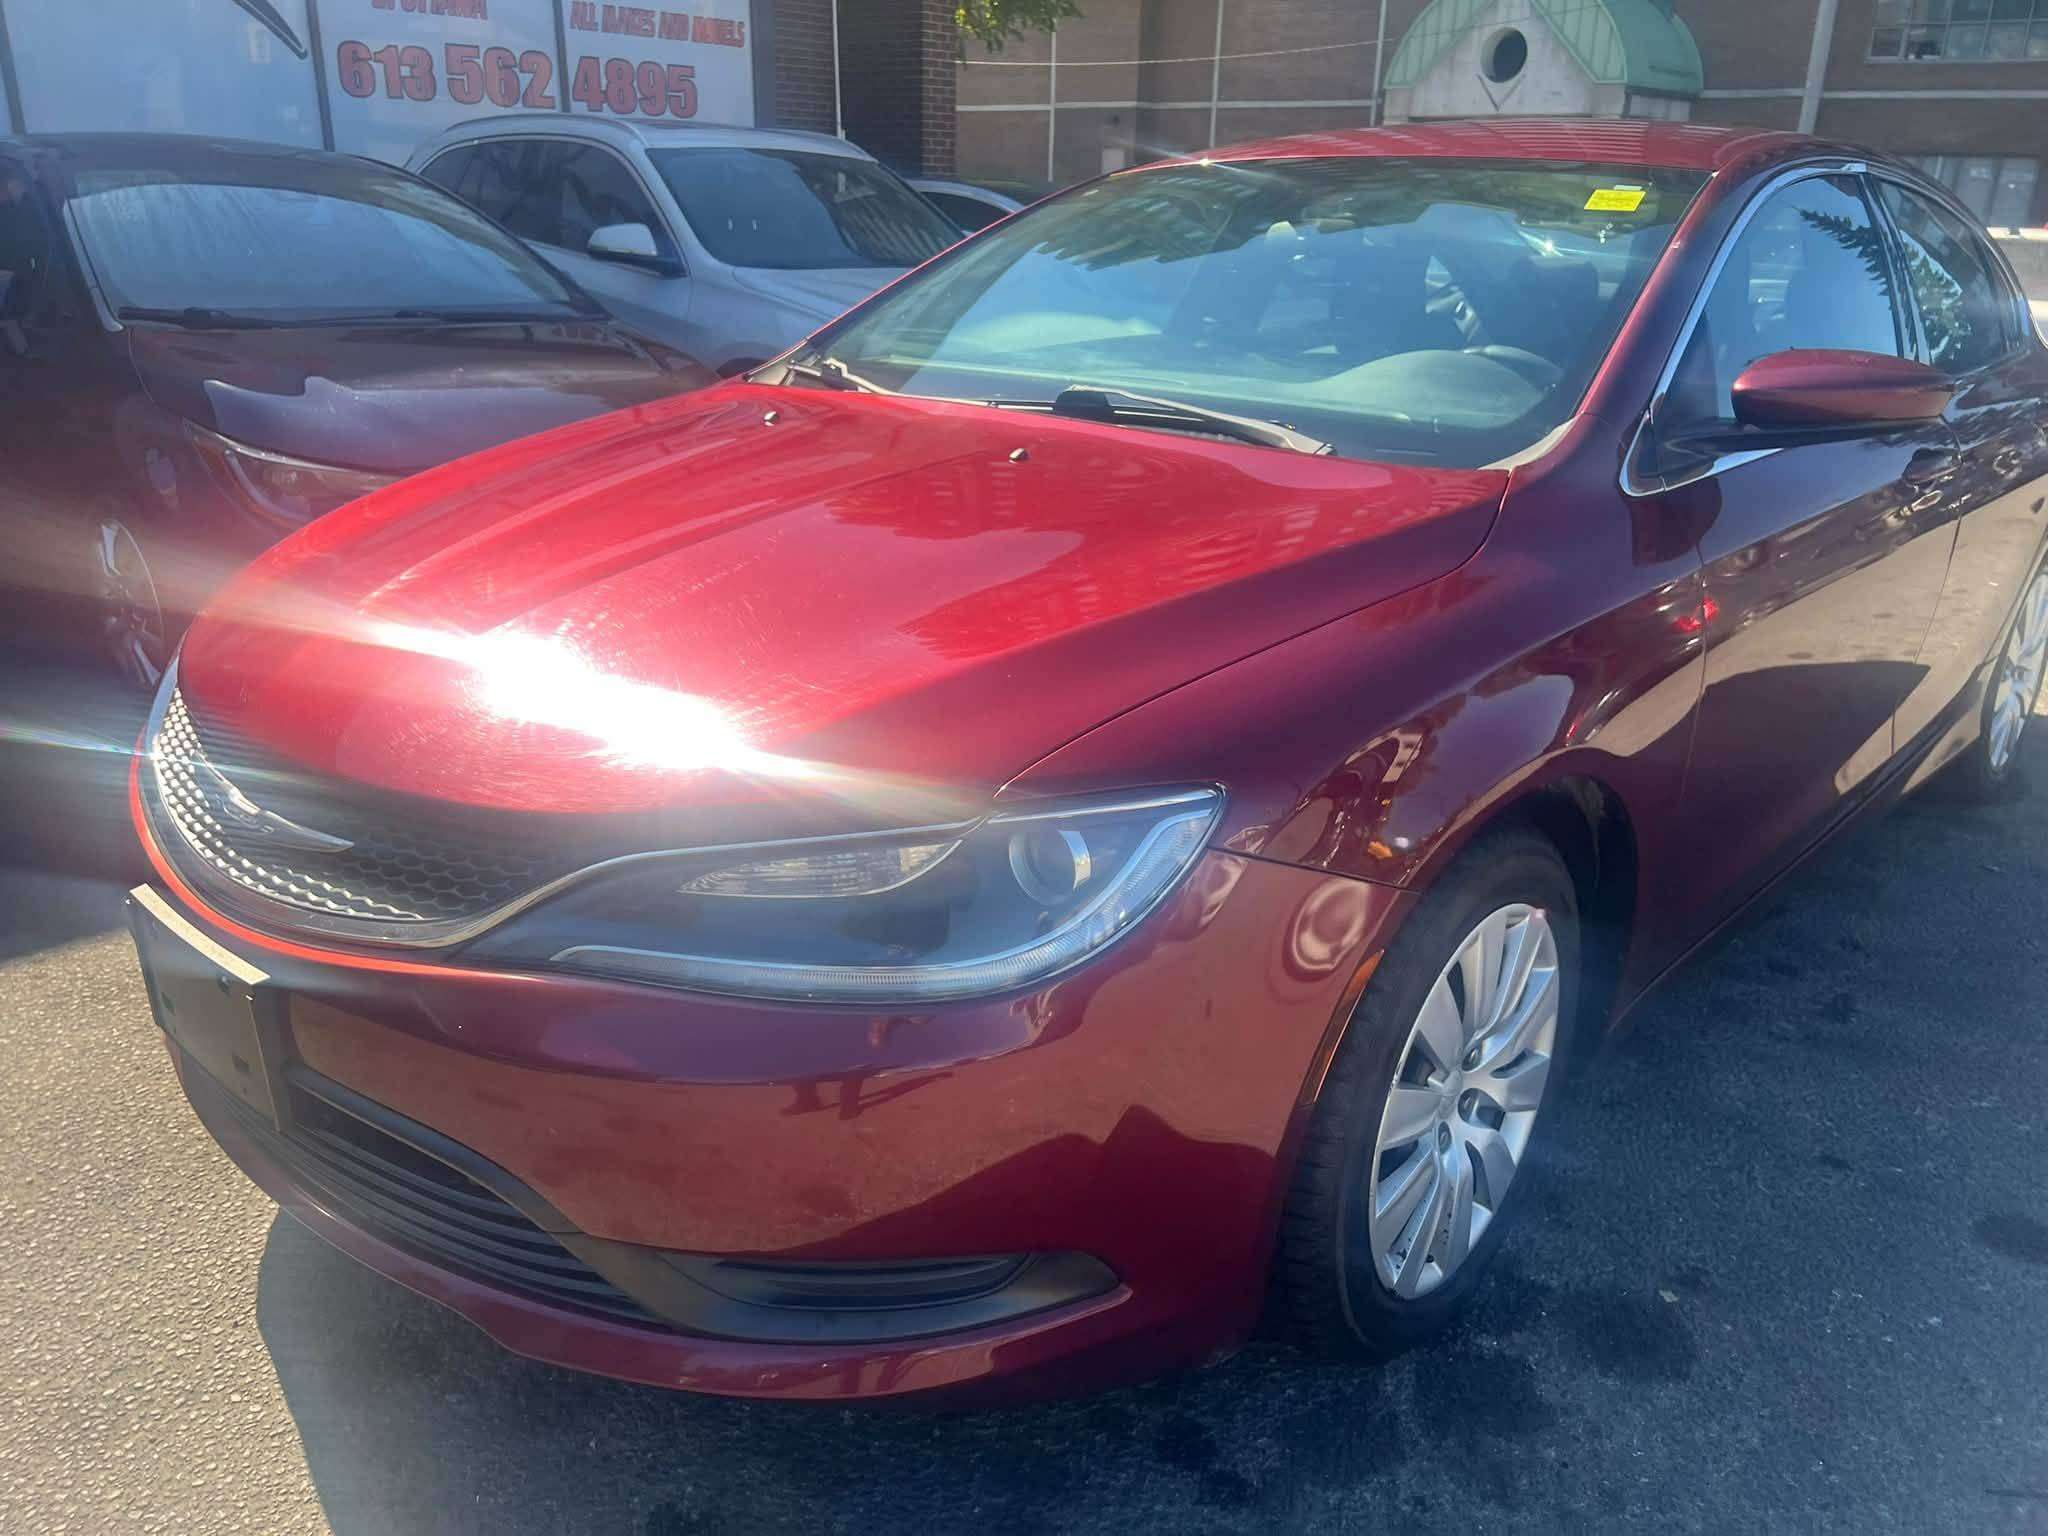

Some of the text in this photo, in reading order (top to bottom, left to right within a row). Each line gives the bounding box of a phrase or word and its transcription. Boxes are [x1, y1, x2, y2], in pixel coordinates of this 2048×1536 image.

[336, 40, 699, 119] 613 562 4895
